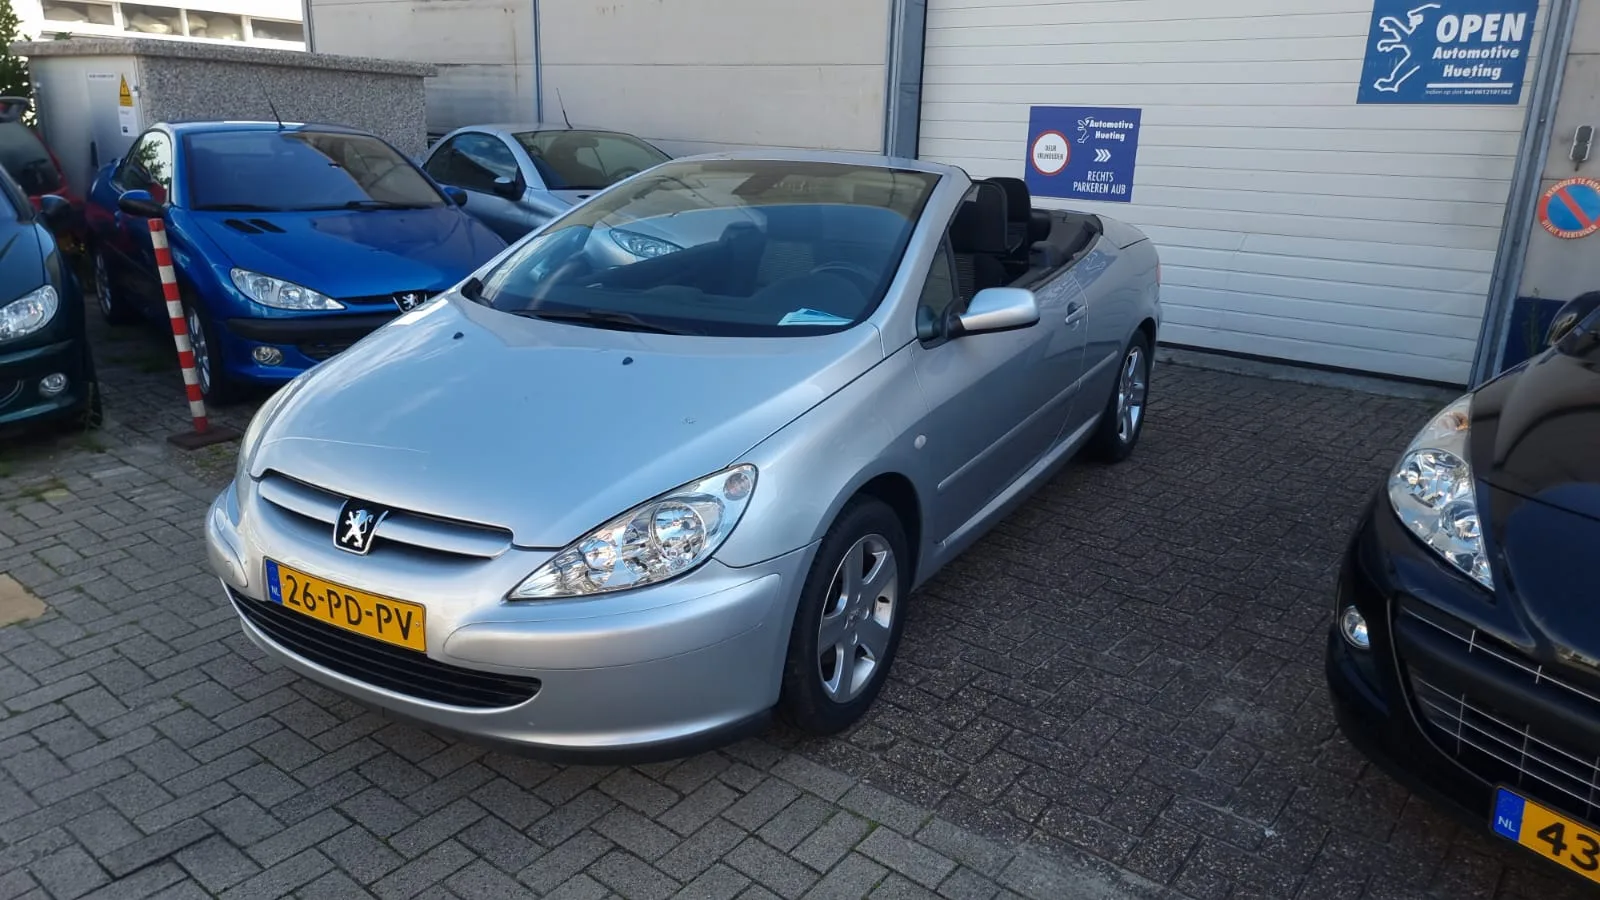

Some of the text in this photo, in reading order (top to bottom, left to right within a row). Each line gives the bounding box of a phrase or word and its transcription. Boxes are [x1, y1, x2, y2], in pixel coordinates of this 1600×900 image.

[1436, 13, 1526, 43] OPEN
[1432, 45, 1520, 60] Automotive
[1443, 64, 1502, 80] Hueting
[1089, 120, 1134, 129] Automotive
[1095, 131, 1125, 142] Hueting
[1087, 171, 1114, 182] RECHTS
[1073, 182, 1126, 194] PARKEREN AUB
[271, 586, 280, 597] NL
[286, 574, 412, 640] 26-PD-PV
[1498, 815, 1516, 832] NL
